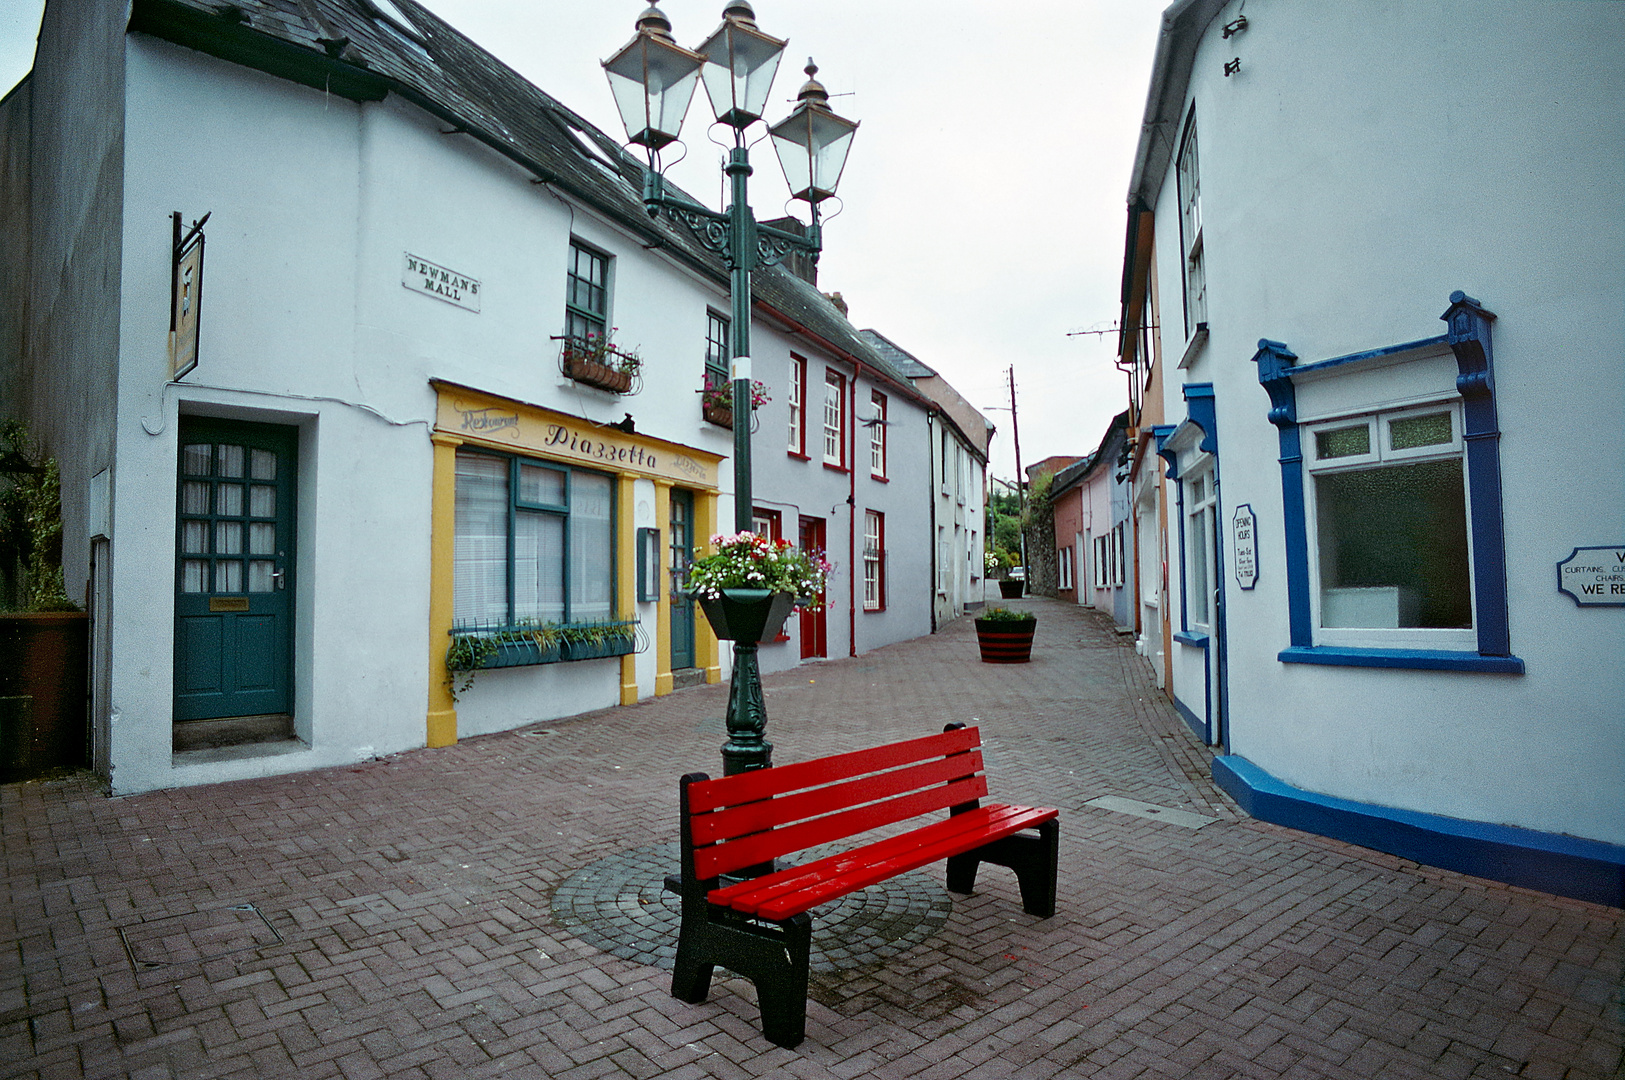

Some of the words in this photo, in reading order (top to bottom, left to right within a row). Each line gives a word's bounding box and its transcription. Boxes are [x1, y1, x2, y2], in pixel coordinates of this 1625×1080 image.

[424, 278, 461, 301] MALL
[461, 411, 519, 431] Restaurant
[544, 424, 657, 469] Piazzetta
[1238, 530, 1250, 540] HOURS
[1581, 584, 1604, 594] WE
